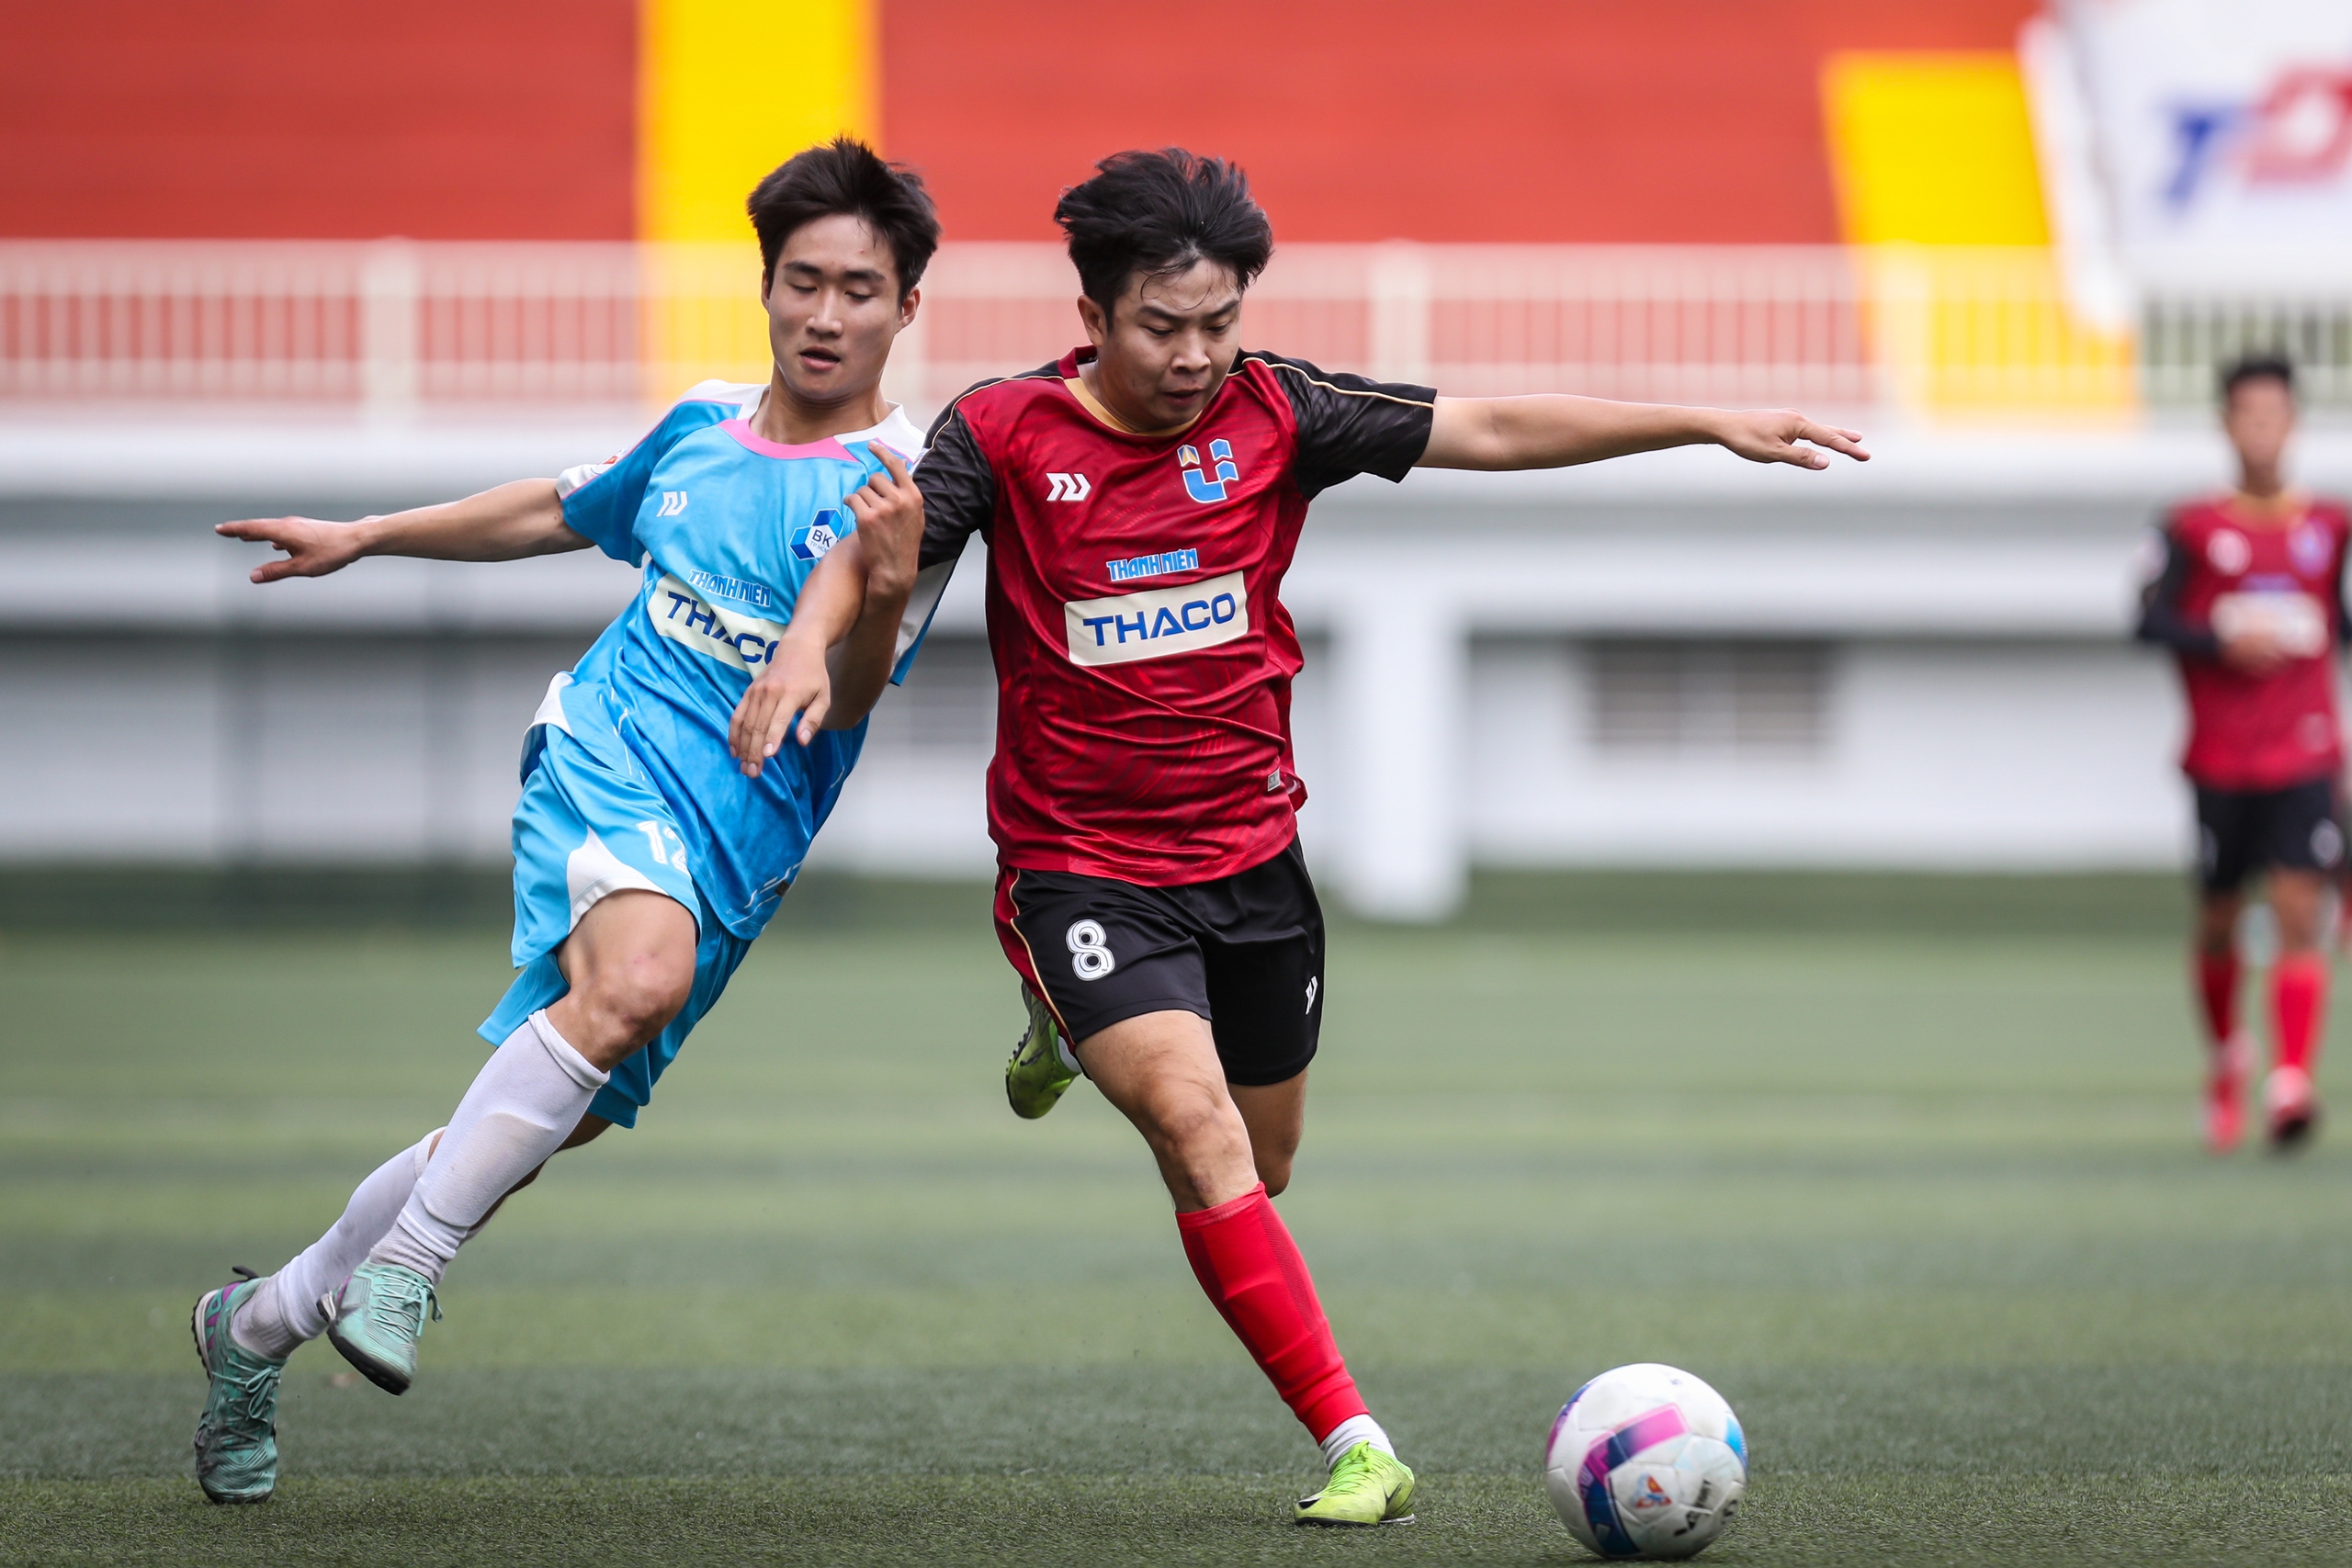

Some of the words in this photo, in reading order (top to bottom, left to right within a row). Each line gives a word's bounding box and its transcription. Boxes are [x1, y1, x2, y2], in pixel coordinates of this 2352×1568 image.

[812, 529, 833, 547] BK
[1106, 554, 1161, 581] THANH
[1160, 547, 1199, 574] NIÊN
[687, 569, 740, 599] THANH
[1083, 592, 1236, 647] THACO
[1066, 919, 1115, 982] 8
